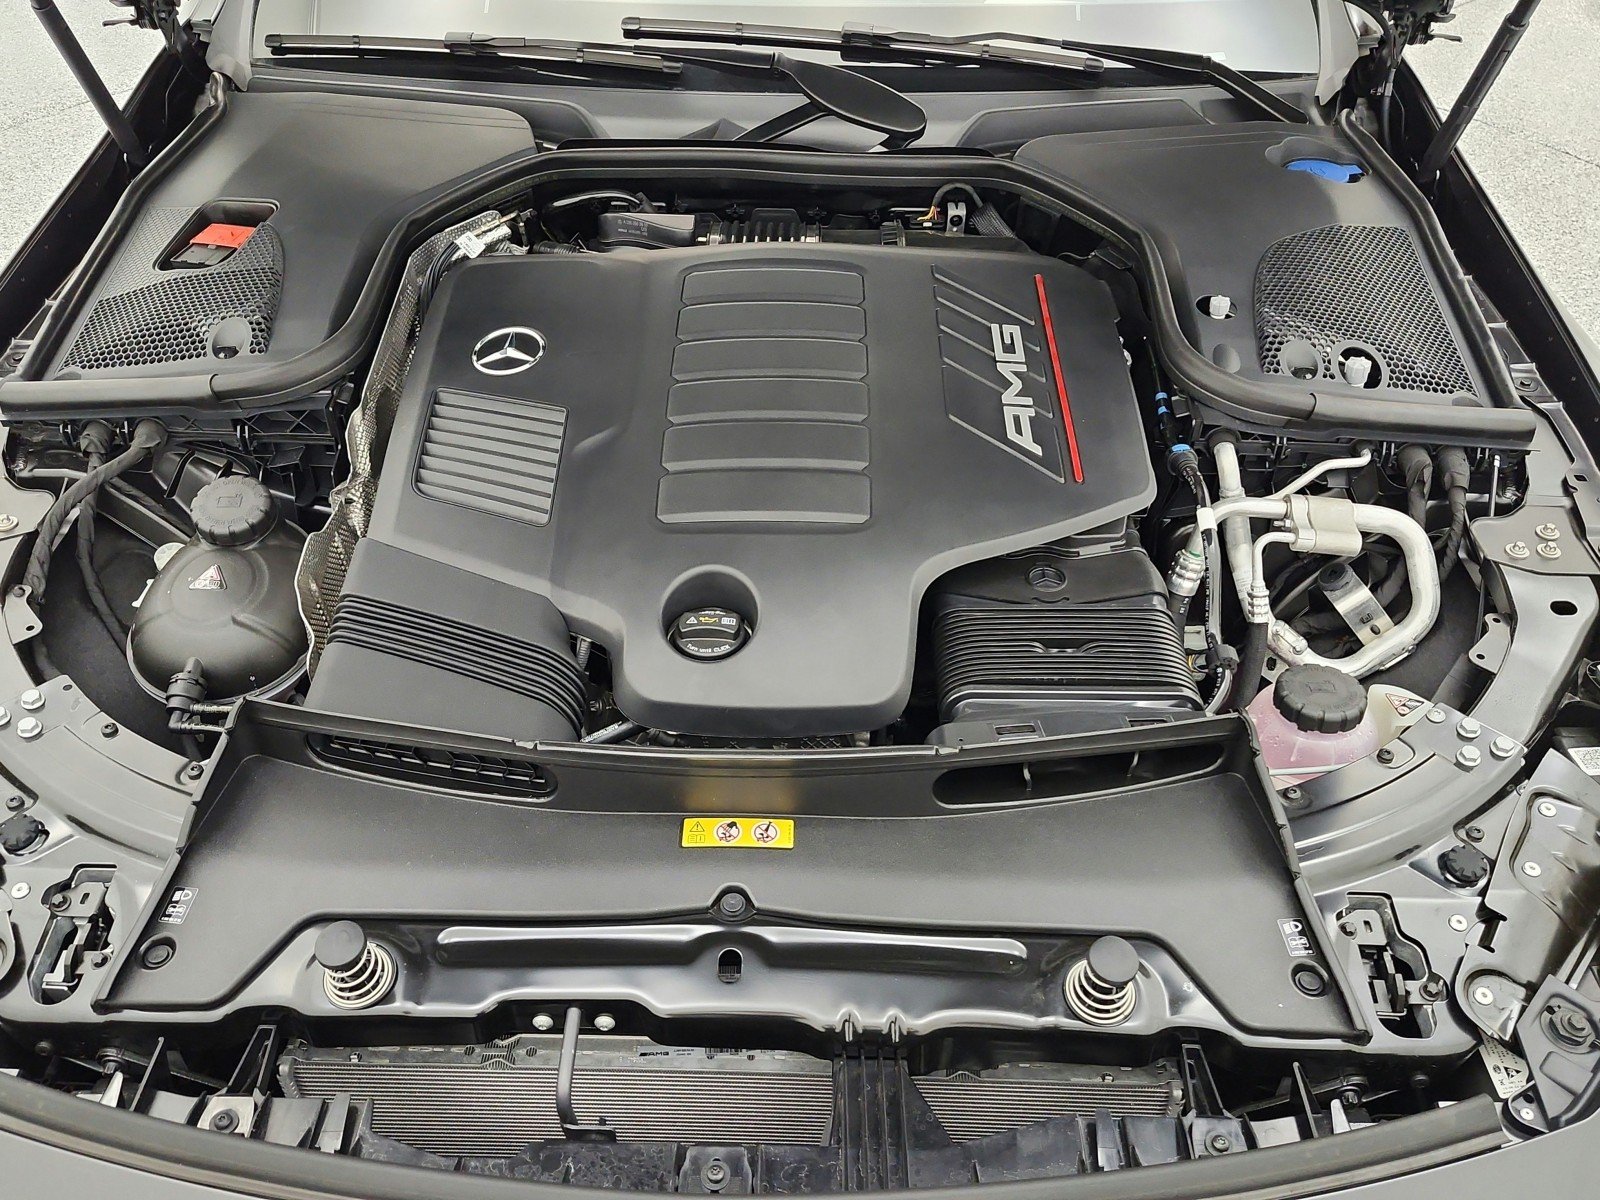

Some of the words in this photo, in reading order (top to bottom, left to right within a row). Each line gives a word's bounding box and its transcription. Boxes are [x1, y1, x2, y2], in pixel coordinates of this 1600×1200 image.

[990, 323, 1043, 456] AMG
[686, 643, 698, 652] Turn
[713, 644, 731, 653] CLICK
